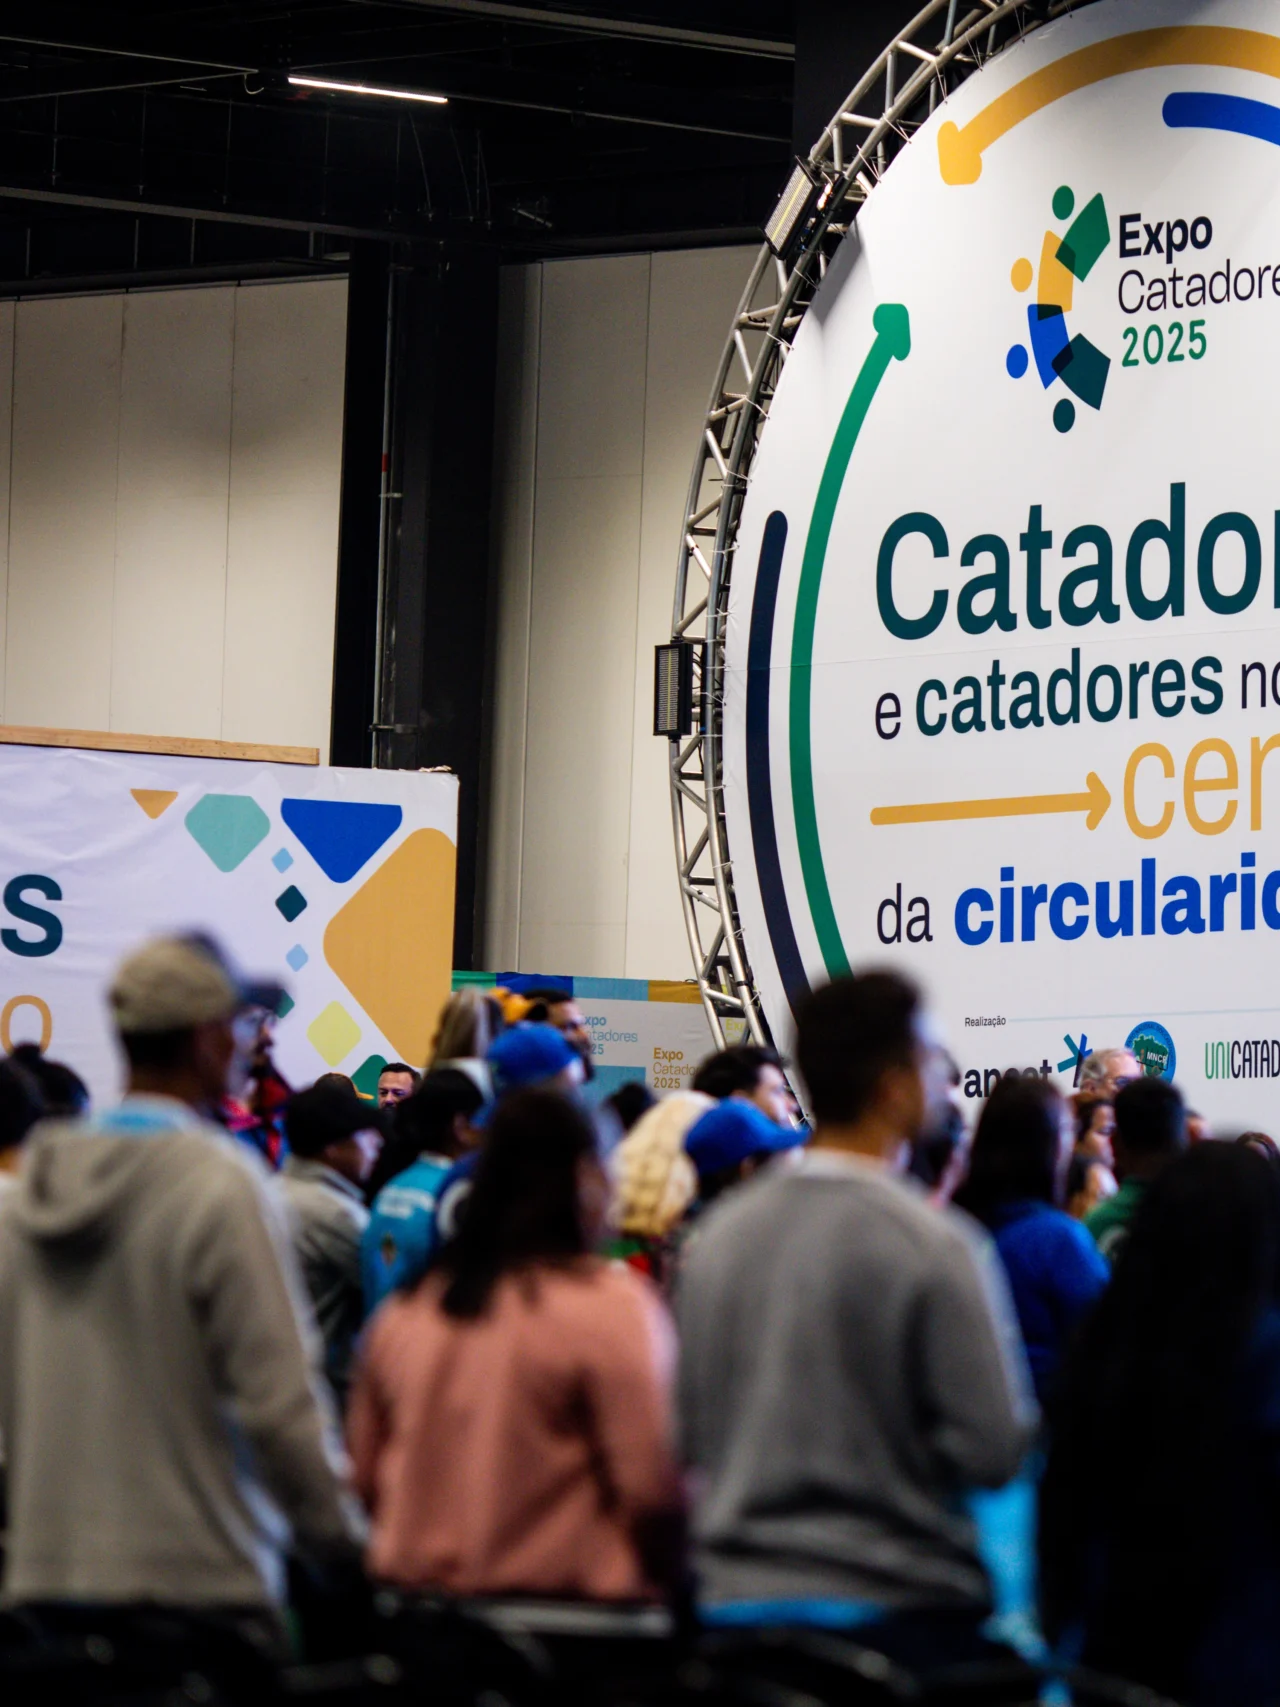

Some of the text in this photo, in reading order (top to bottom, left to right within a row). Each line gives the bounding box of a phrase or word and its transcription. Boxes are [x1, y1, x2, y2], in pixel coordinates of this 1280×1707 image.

[1119, 213, 1213, 264] Expo
[1121, 319, 1208, 367] 2025
[874, 691, 902, 740] e
[915, 648, 1225, 737] catadores
[876, 883, 934, 945] da
[964, 1014, 1007, 1028] Realização
[653, 1047, 684, 1062] Expo
[653, 1078, 681, 1089] 2025
